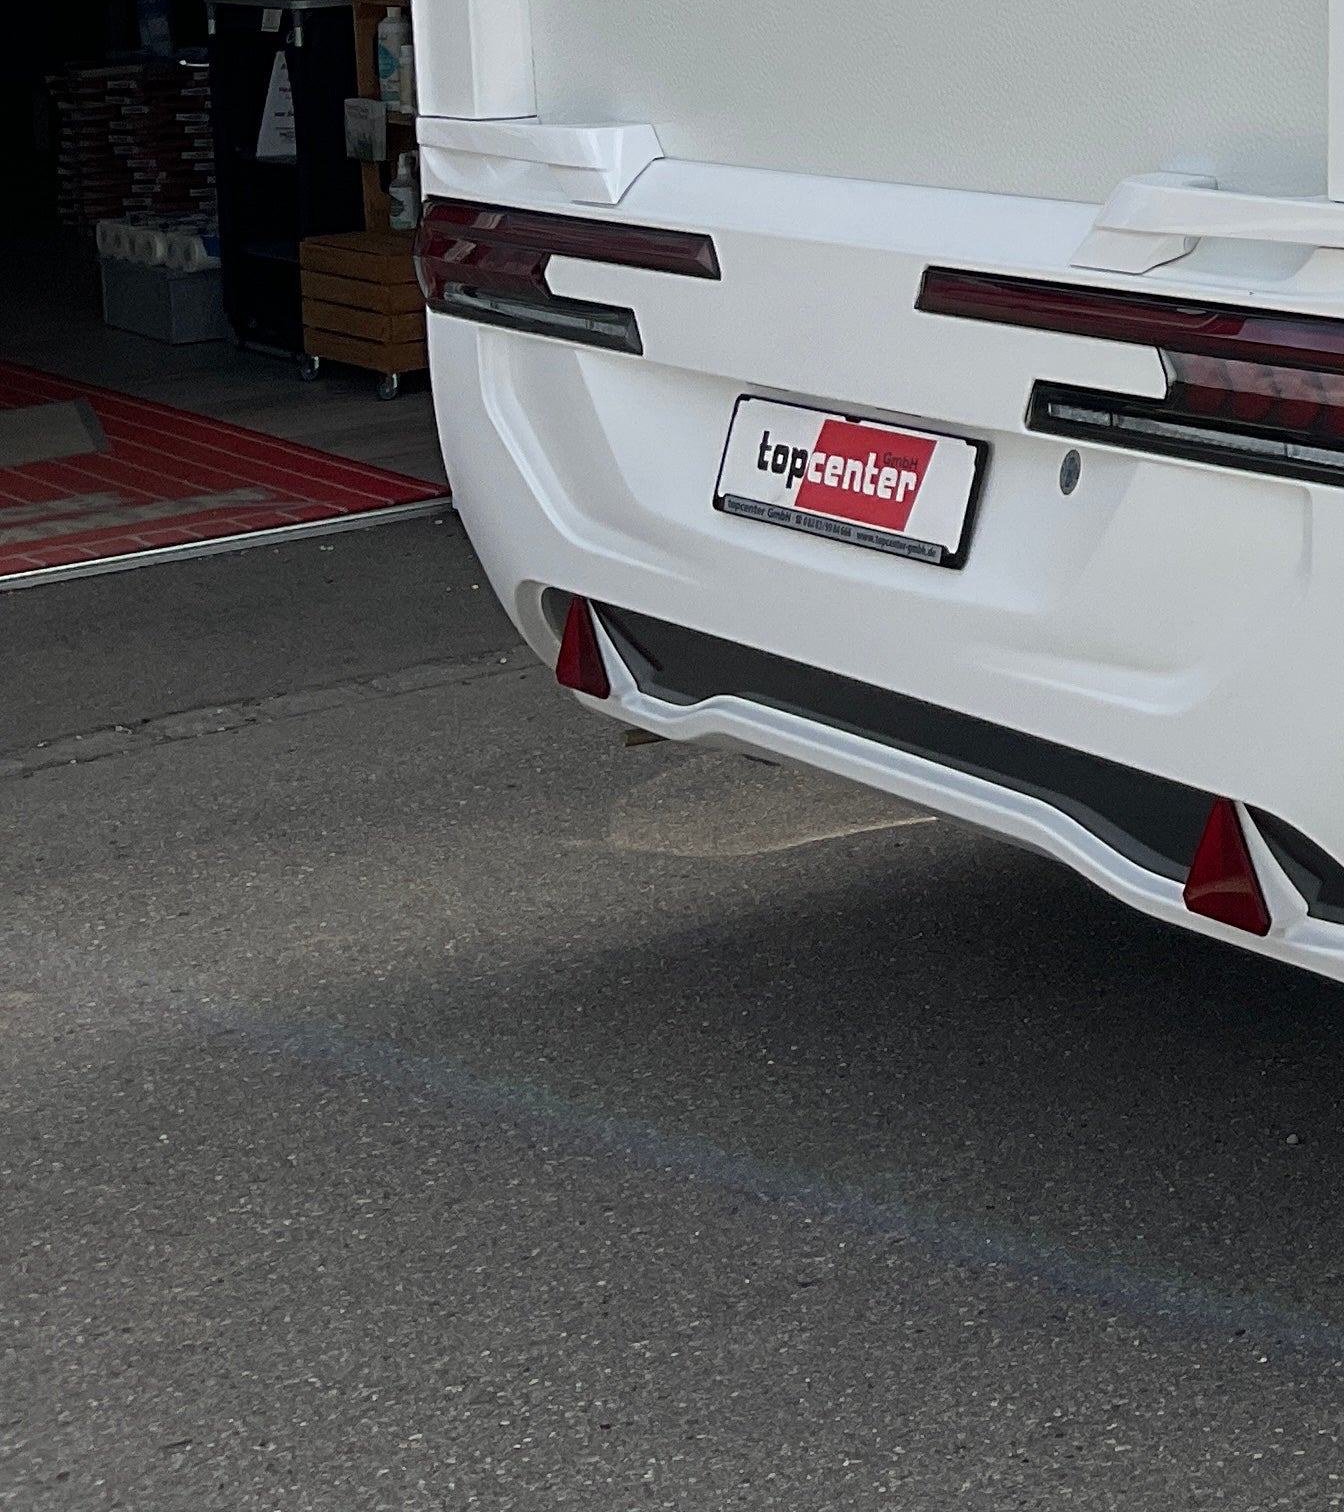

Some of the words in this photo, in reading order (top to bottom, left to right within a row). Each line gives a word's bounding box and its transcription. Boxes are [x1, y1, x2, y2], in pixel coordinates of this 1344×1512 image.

[757, 430, 917, 502] topcenter
[883, 452, 918, 469] GmbH
[728, 499, 765, 515] topcenter
[767, 508, 791, 523] GmbH
